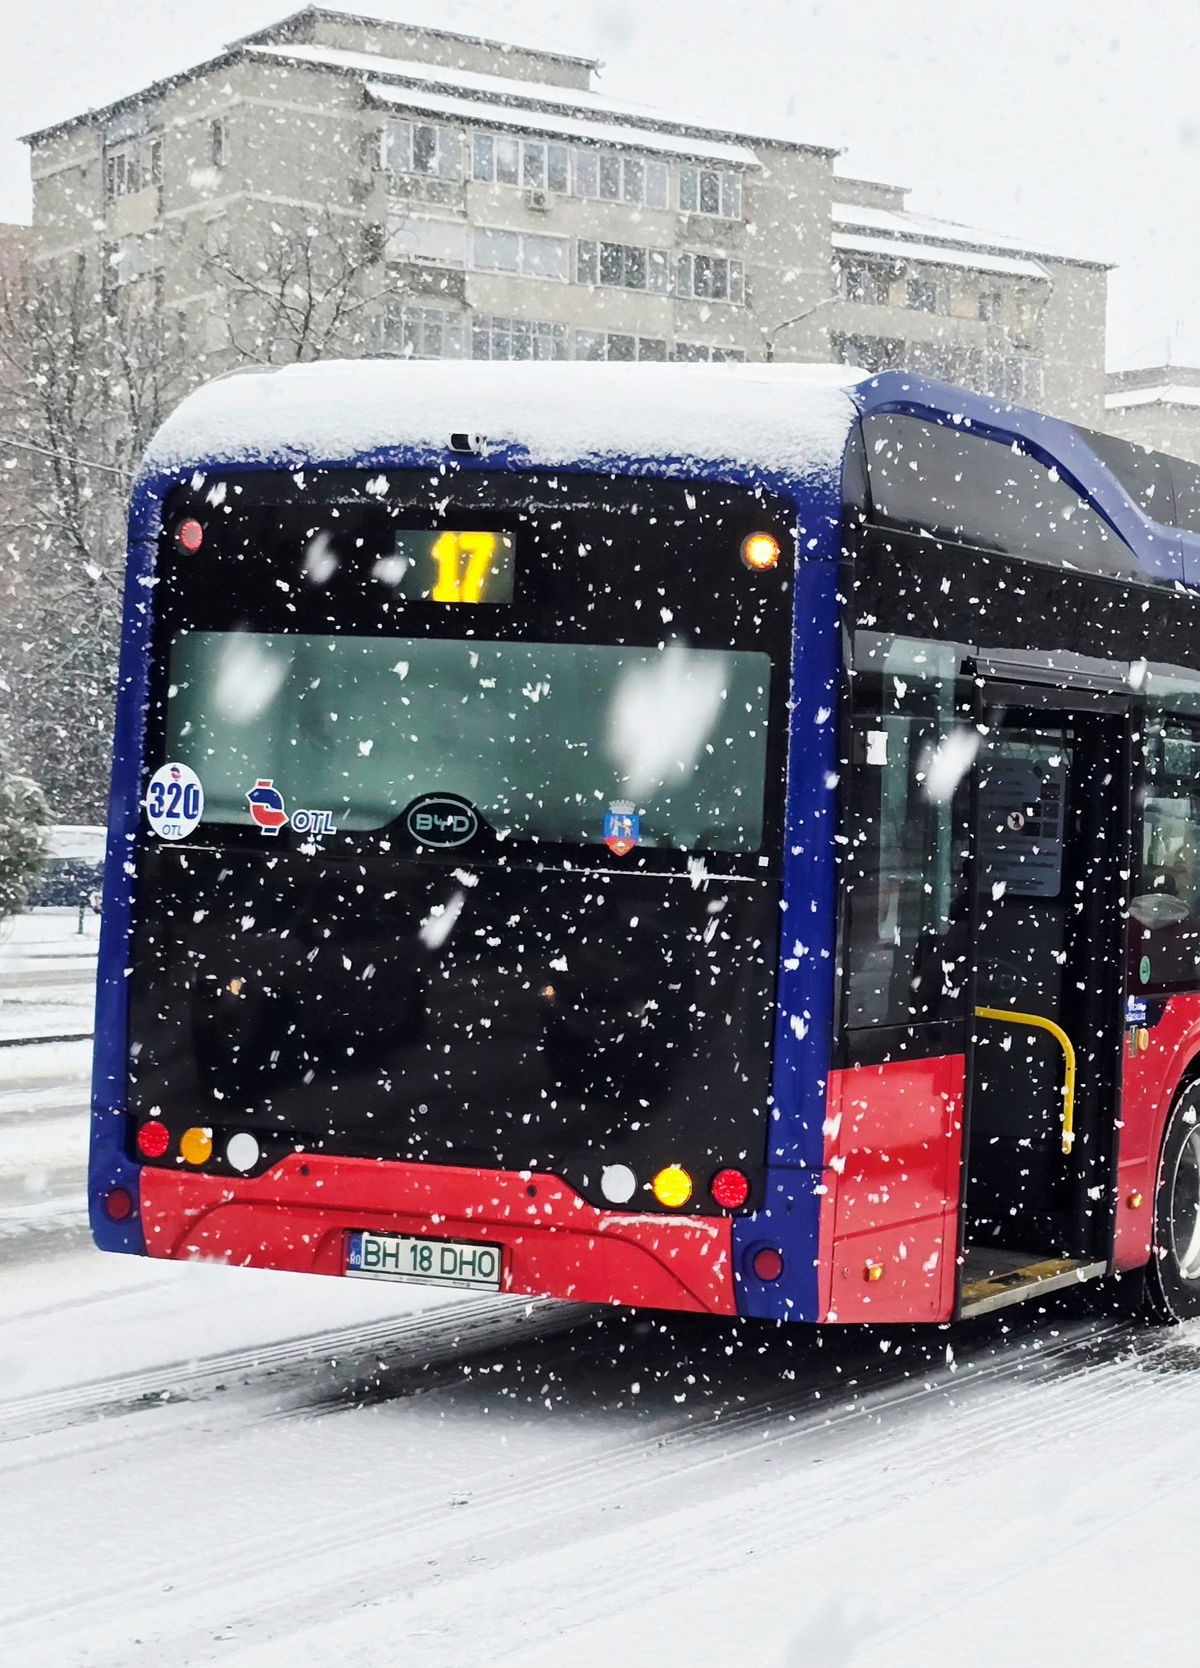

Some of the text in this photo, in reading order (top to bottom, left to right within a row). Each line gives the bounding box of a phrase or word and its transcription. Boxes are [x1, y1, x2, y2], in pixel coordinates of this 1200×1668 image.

[432, 532, 495, 603] 17
[150, 781, 200, 820] 320
[162, 824, 183, 837] OTL
[292, 810, 336, 834] OTL
[416, 813, 470, 832] BYD
[364, 1239, 495, 1278] BH 18 DHO
